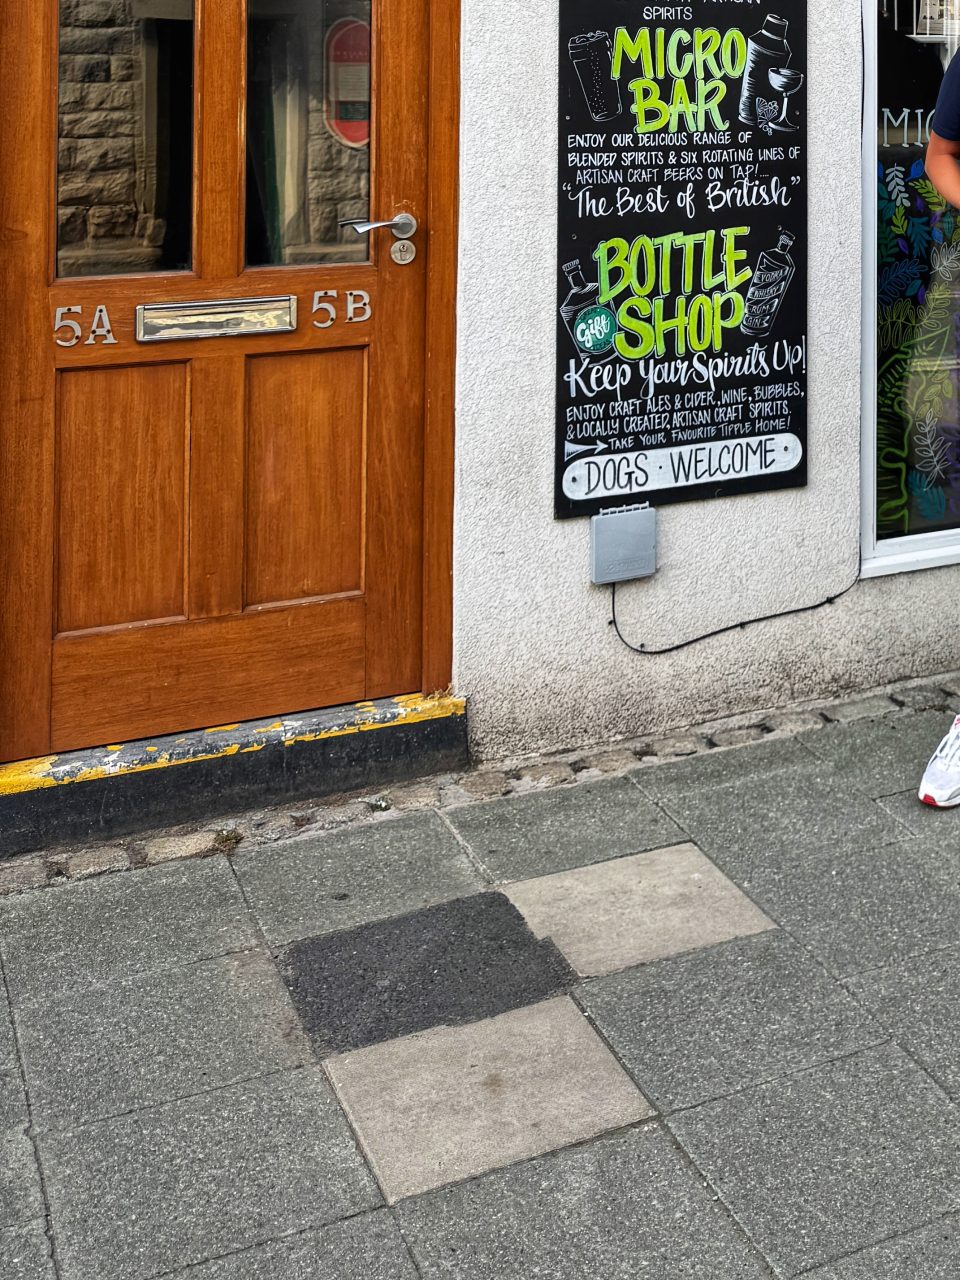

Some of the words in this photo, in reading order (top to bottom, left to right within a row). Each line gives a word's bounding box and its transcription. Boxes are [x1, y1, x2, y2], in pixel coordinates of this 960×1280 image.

[643, 7, 693, 21] SPIRITS
[610, 26, 748, 80] MICRO
[628, 77, 729, 134] BAR
[567, 133, 606, 148] ENJOY
[611, 133, 634, 147] OUR
[637, 132, 688, 147] DELICIOUS
[693, 131, 732, 145] RANGE
[738, 131, 753, 144] OF
[567, 151, 617, 167] BLENDED
[621, 150, 664, 166] SPIRITS
[668, 151, 677, 165] &
[680, 150, 697, 164] SIX
[702, 148, 754, 164] ROTATING
[758, 146, 785, 161] LINES
[788, 146, 800, 160] OF
[575, 168, 623, 185] ARTISAN
[627, 168, 660, 183] CRAFT
[663, 166, 703, 182] BEERS
[707, 166, 724, 179] ON
[616, 183, 670, 217] Best
[676, 182, 695, 219] of
[592, 226, 753, 305] BOTTLE
[53, 305, 118, 347] 5A
[311, 289, 372, 328] 5B
[613, 291, 748, 360] SHOP
[747, 317, 762, 328] GIN
[751, 304, 769, 315] RUM
[563, 357, 632, 401] Keep
[639, 358, 694, 400] Your
[691, 341, 771, 391] Spirits
[773, 335, 807, 376] Up!
[566, 405, 606, 422] ENJOY
[609, 400, 642, 417] CRAFT
[647, 397, 671, 414] ALES
[674, 396, 682, 410] &
[754, 382, 805, 399] BUBBLES,
[566, 424, 575, 440] &
[577, 421, 619, 439] LOCALLY
[672, 411, 711, 428] ARTISAN
[714, 404, 743, 421] CRAFT
[749, 400, 792, 418] SPIRITS.
[608, 438, 635, 451] TAKE
[639, 432, 667, 446] YOUR
[671, 426, 717, 443] FAVOURITE
[718, 421, 752, 435] TIPPLE
[755, 415, 791, 432] HOME!
[584, 452, 649, 496] DOGS
[669, 437, 777, 485] WELCOME
